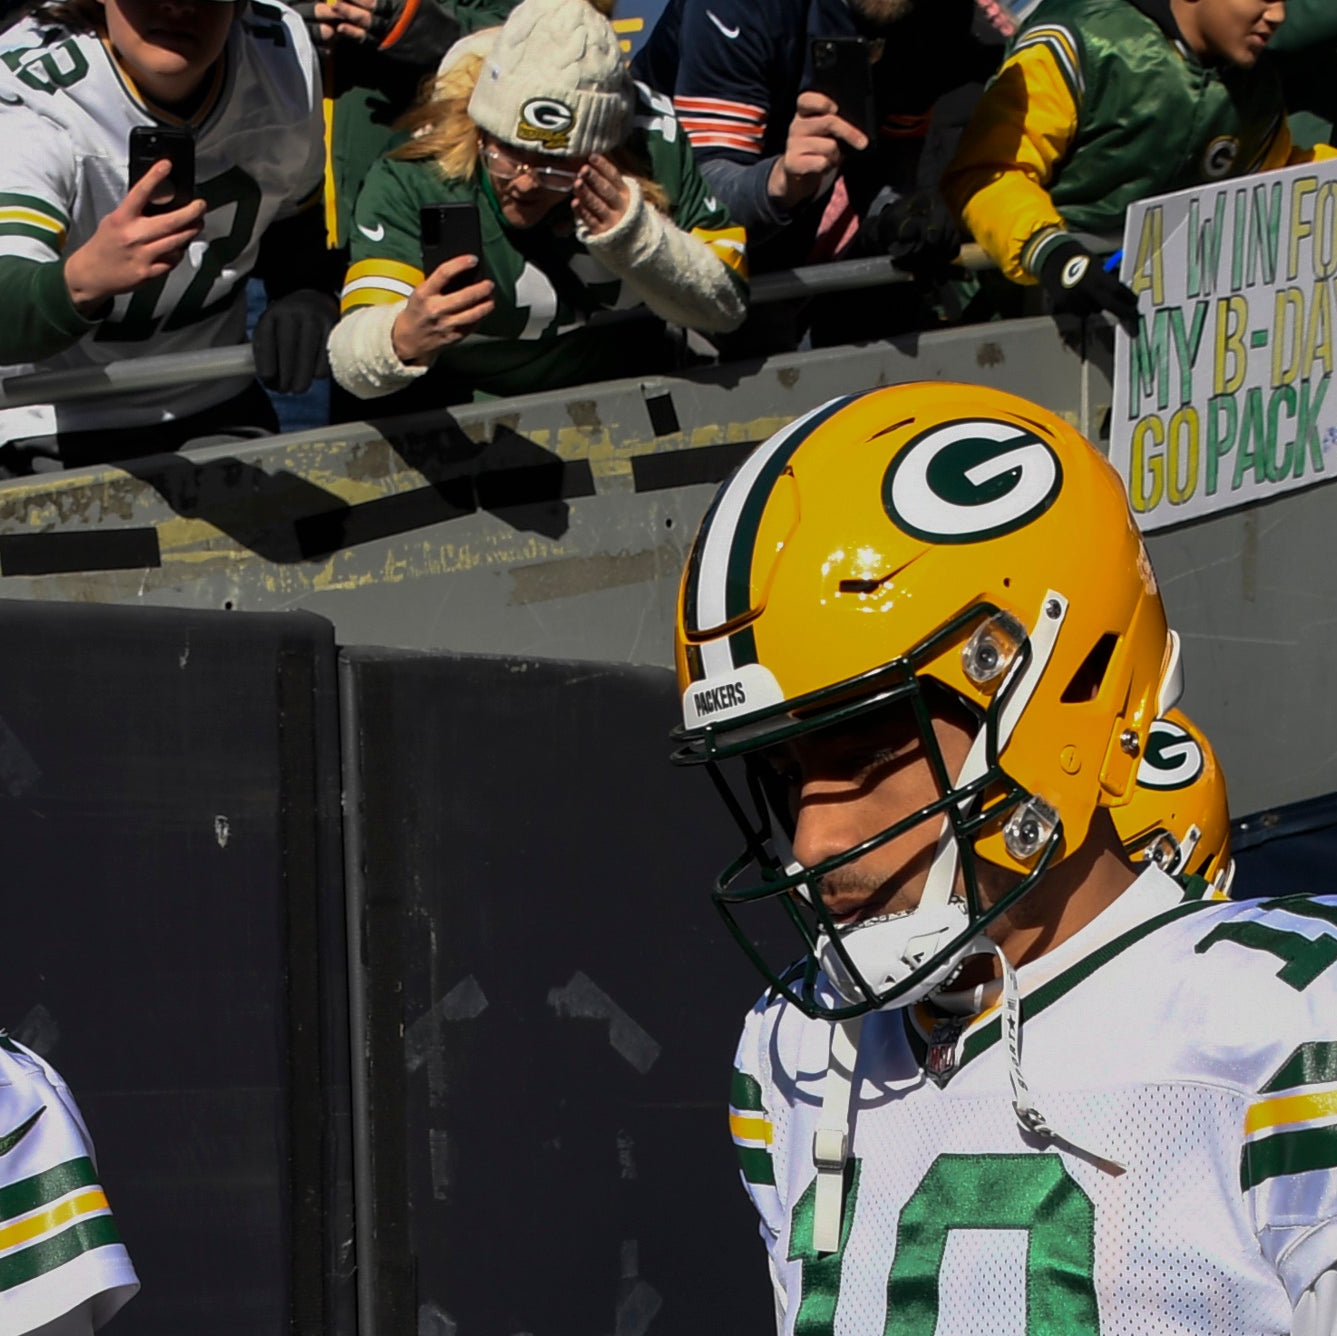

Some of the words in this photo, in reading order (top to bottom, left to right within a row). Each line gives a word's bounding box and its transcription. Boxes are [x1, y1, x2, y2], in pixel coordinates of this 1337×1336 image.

[1131, 204, 1164, 307] A
[1186, 181, 1283, 300] WIN
[1128, 299, 1209, 421] MY
[890, 423, 1060, 537] G
[1128, 404, 1200, 513] GO
[1205, 371, 1332, 496] PACK
[693, 681, 746, 718] PACKERS
